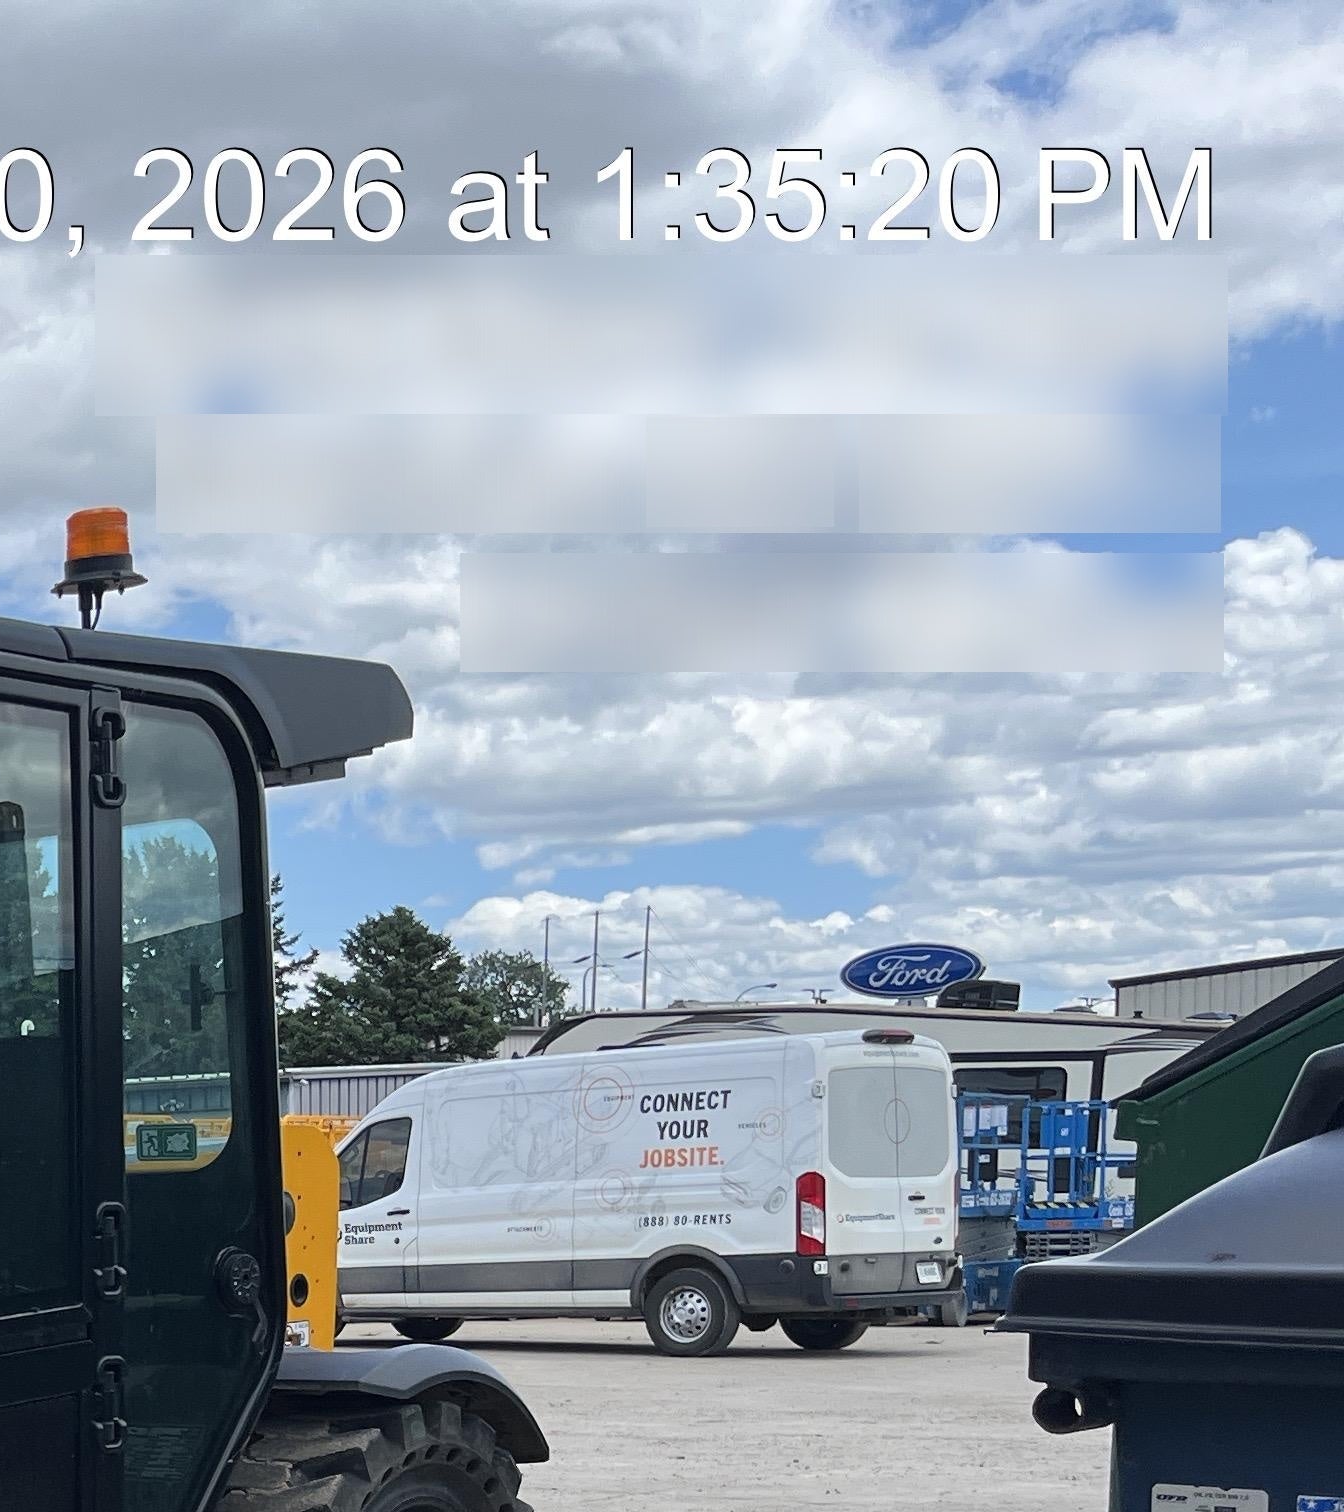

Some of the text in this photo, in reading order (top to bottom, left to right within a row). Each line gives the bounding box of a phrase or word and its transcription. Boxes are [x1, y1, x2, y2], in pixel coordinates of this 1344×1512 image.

[869, 954, 952, 988] Ford
[640, 1089, 732, 1114] CONNECT
[657, 1119, 709, 1140] YOUR
[639, 1146, 725, 1169] JOBSITE.
[344, 1221, 403, 1235] Equipment
[638, 1213, 732, 1229] (888) 80-RENTS
[344, 1235, 375, 1245] Share
